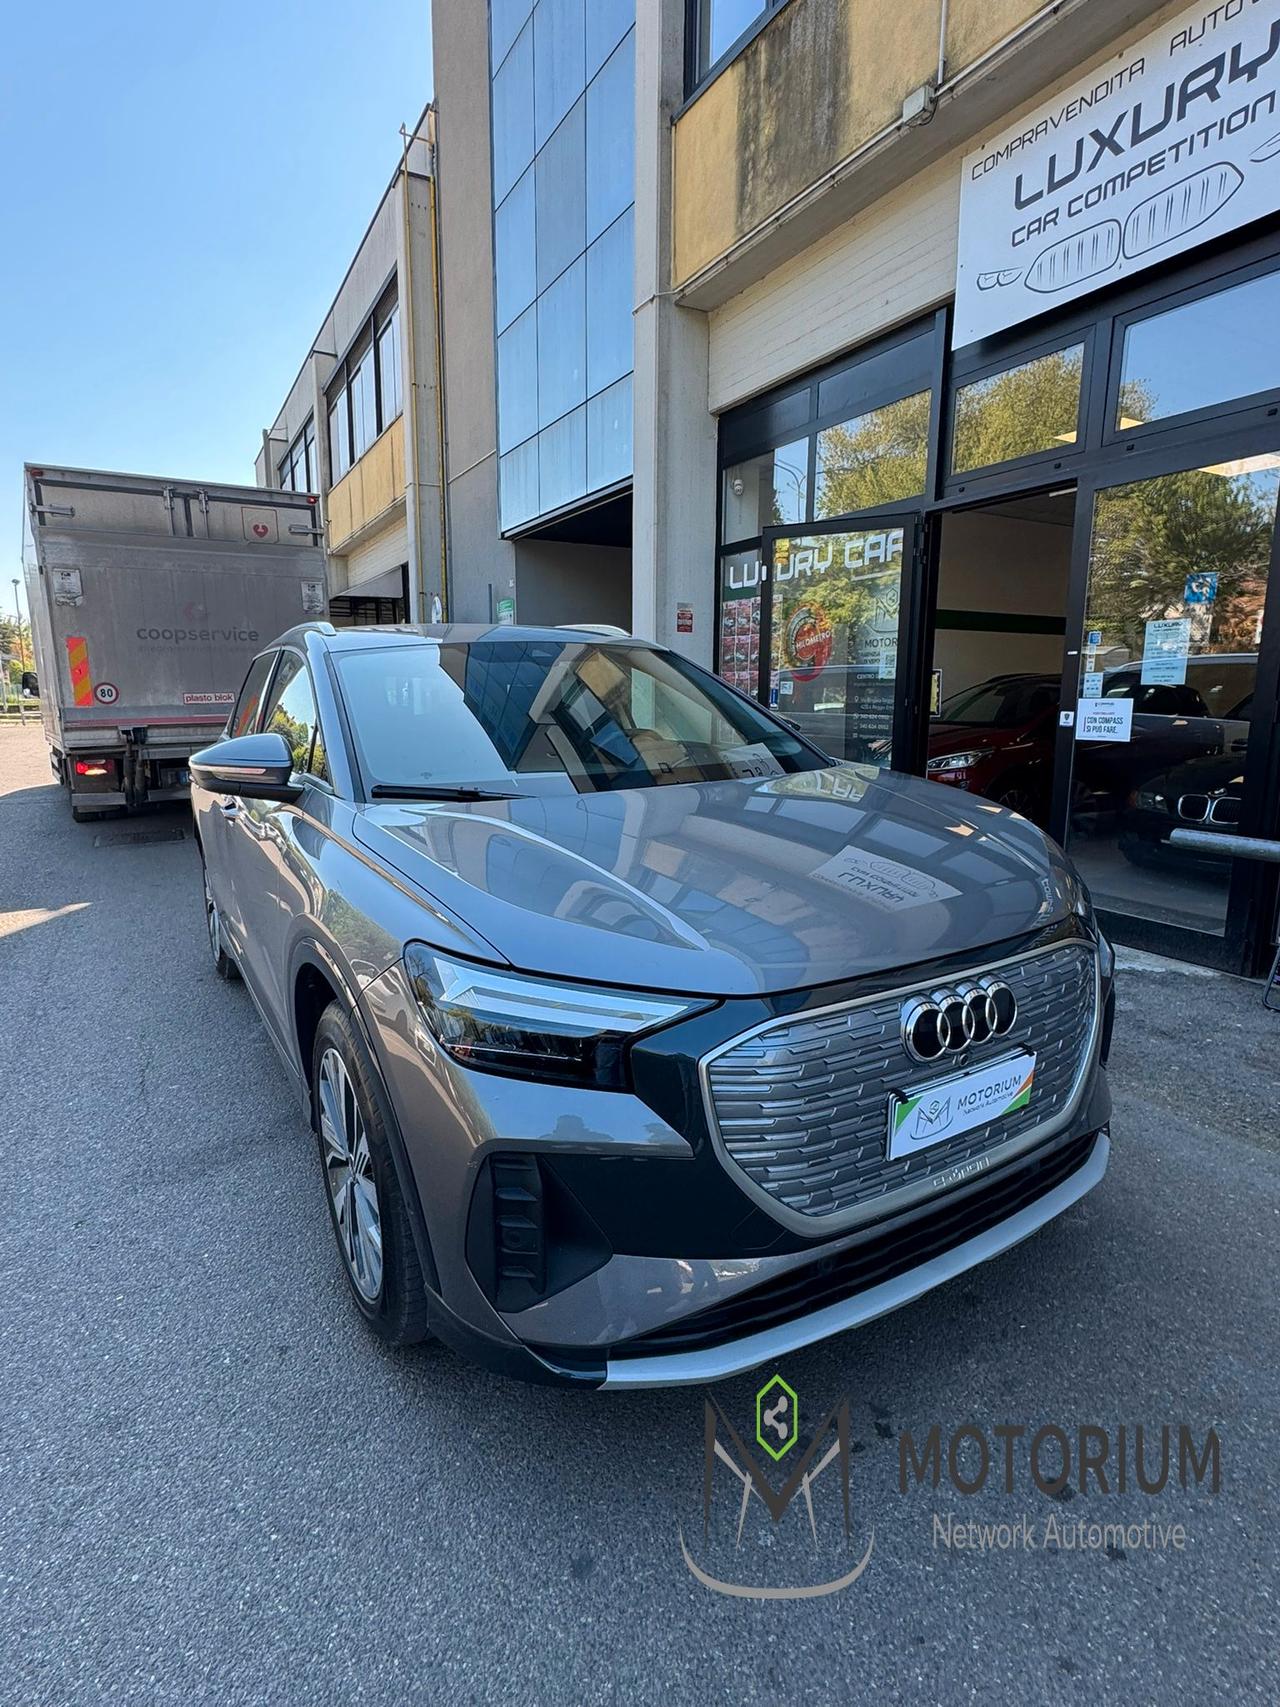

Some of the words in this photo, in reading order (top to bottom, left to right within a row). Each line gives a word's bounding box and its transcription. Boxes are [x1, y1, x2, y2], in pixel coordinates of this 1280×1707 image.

[971, 57, 1145, 181] COMPRAVENDITA
[1169, 0, 1243, 56] AUTO
[1014, 20, 1280, 211] LUXURY
[1011, 208, 1059, 247] CAR
[1067, 90, 1277, 218] COMPETITION
[729, 542, 833, 590] LUURY
[136, 626, 259, 644] coopservice
[100, 688, 113, 698] 80
[185, 695, 212, 703] plasto
[214, 693, 234, 701] blok
[1098, 716, 1124, 724] COMPASS
[957, 1074, 1021, 1110] MOTORIUM
